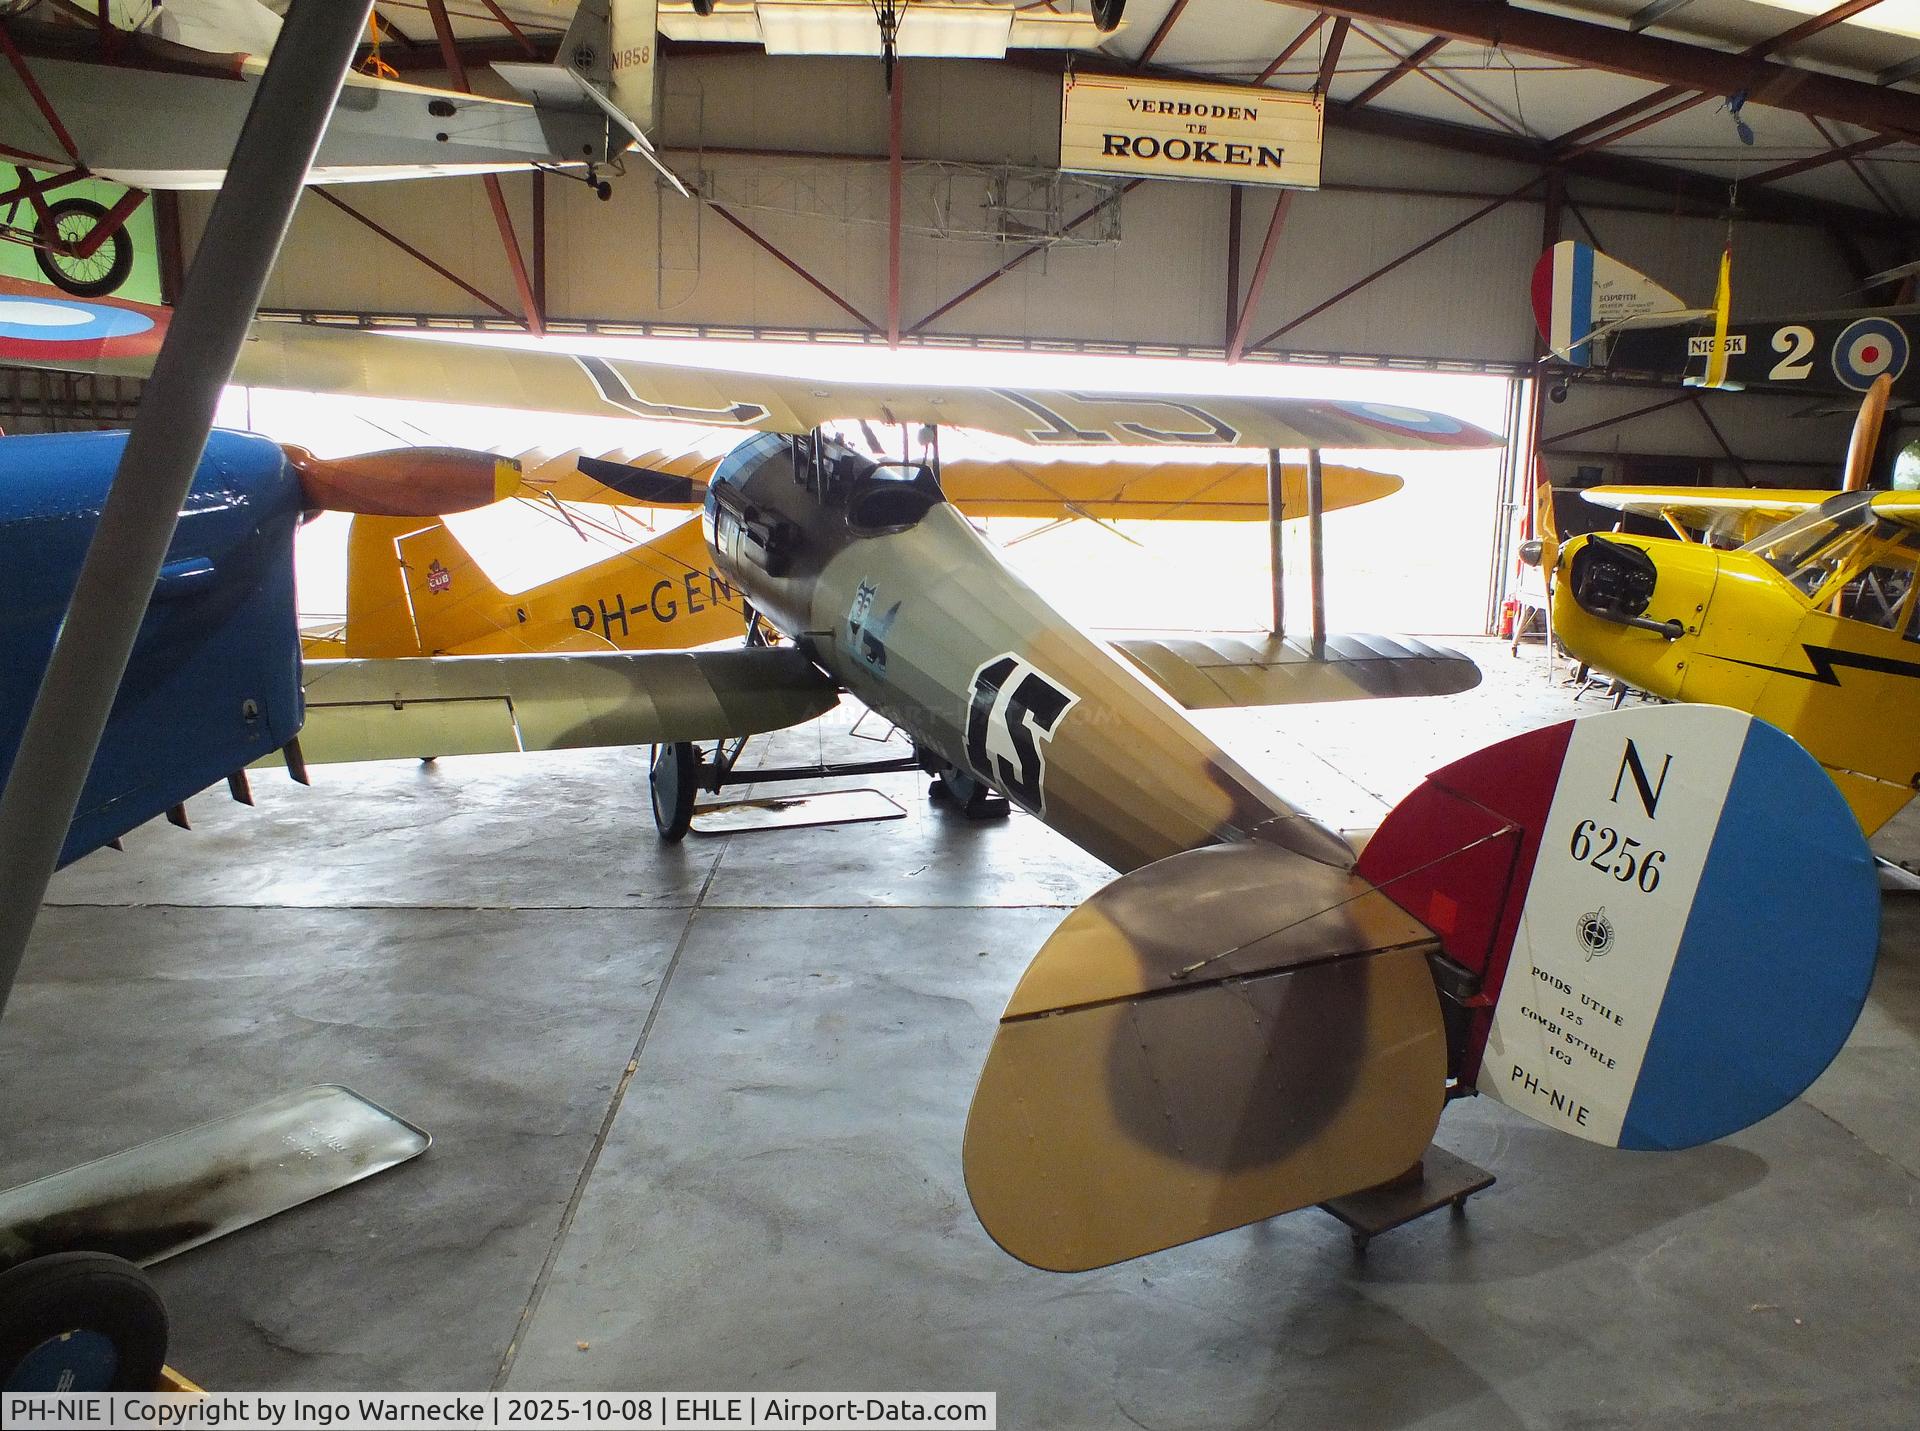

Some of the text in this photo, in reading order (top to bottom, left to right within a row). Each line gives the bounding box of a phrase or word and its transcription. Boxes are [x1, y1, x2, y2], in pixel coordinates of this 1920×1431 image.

[611, 46, 650, 71] N1858
[1127, 98, 1259, 121] VERBODEN
[1185, 123, 1208, 135] TE
[1102, 133, 1285, 168] ROOKEN
[1691, 336, 1742, 353] N195K
[1768, 325, 1815, 380] 2
[430, 574, 449, 588] CUB
[571, 567, 732, 642] PH-GEN
[962, 651, 1081, 820] 15
[1609, 737, 1674, 820] N
[1570, 819, 1666, 893] 6256
[1531, 966, 1572, 995] POIDS
[1560, 1006, 1583, 1026] 125
[1511, 1064, 1590, 1126] PH-NIE
